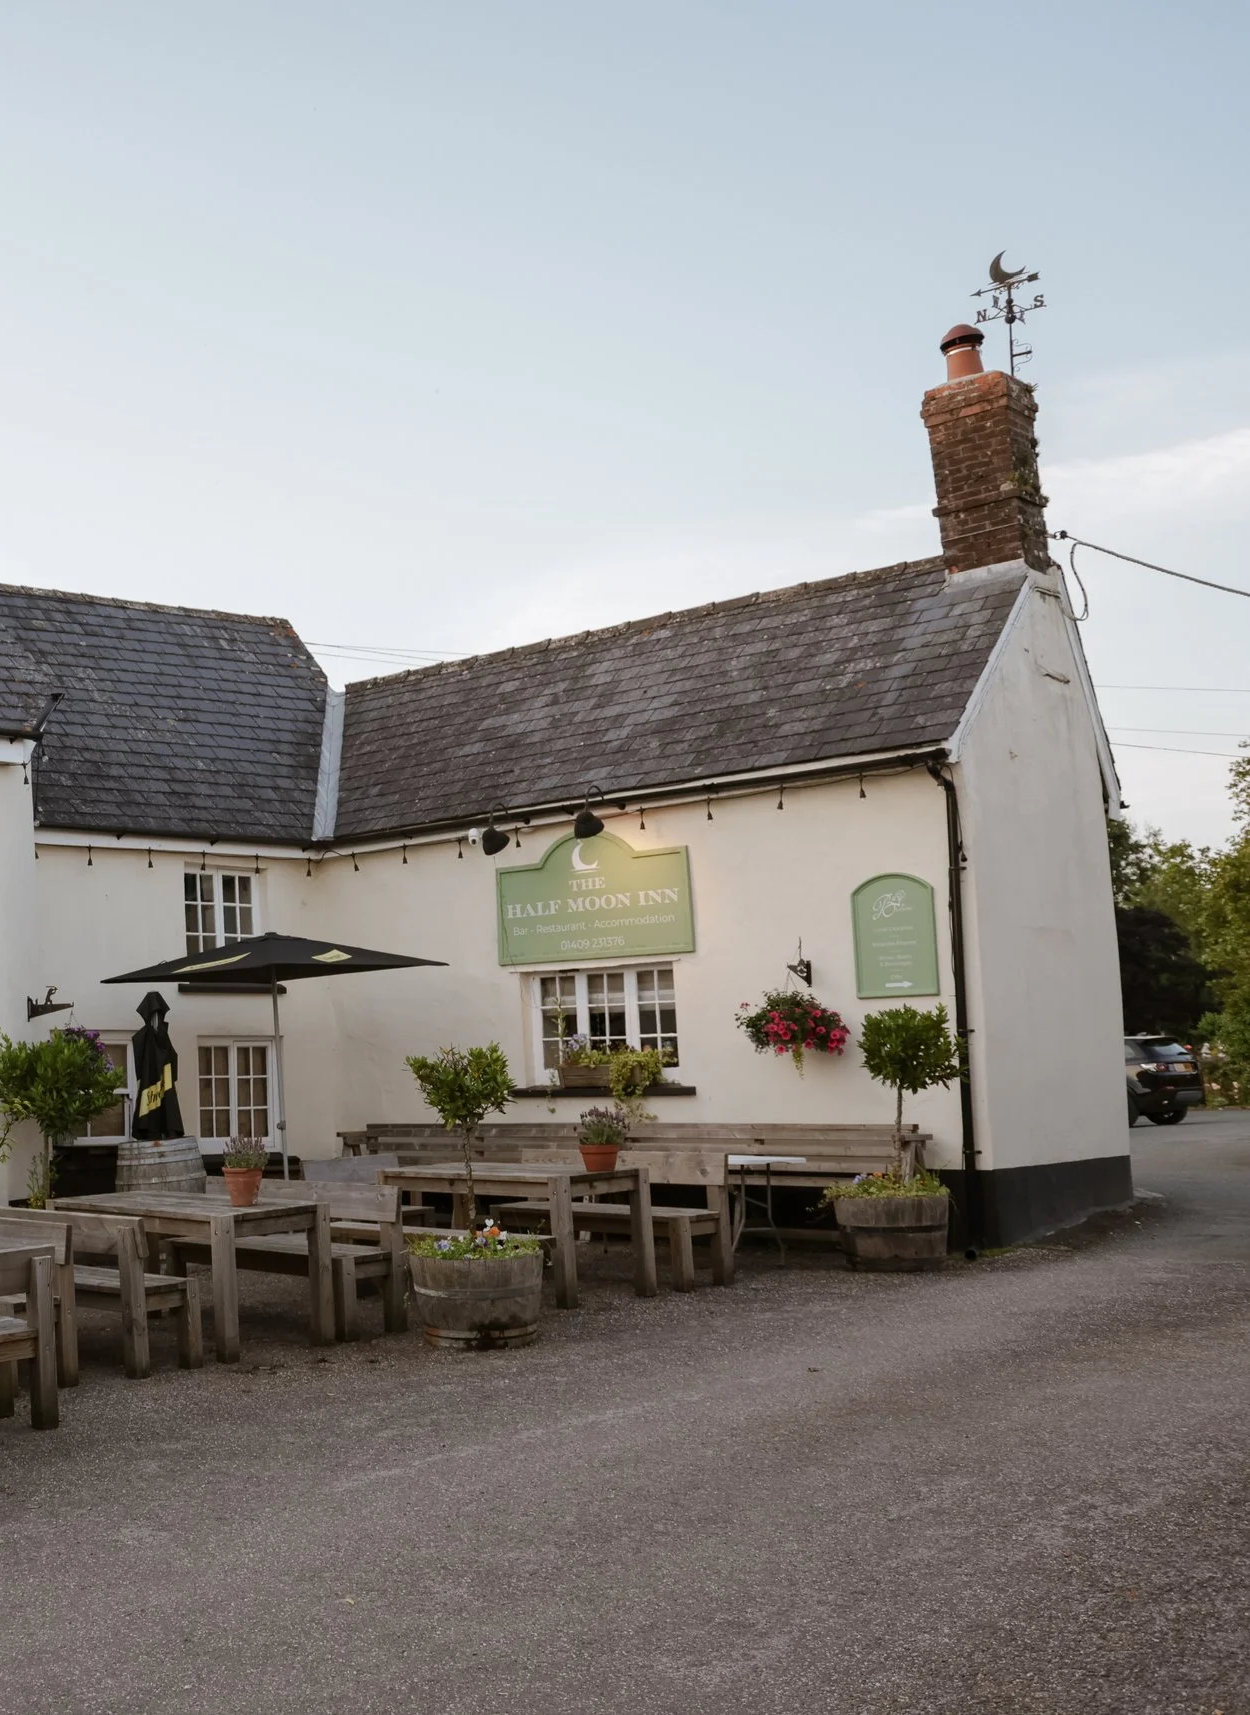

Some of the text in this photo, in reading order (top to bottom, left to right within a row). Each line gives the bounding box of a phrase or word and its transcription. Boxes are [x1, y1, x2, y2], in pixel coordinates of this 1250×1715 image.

[569, 876, 605, 892] THE
[506, 888, 679, 918] HALF MOON INN
[513, 926, 528, 936] Bar
[536, 922, 586, 934] Restaurant
[594, 914, 676, 929] Accommodation
[560, 936, 625, 950] 01409 231376
